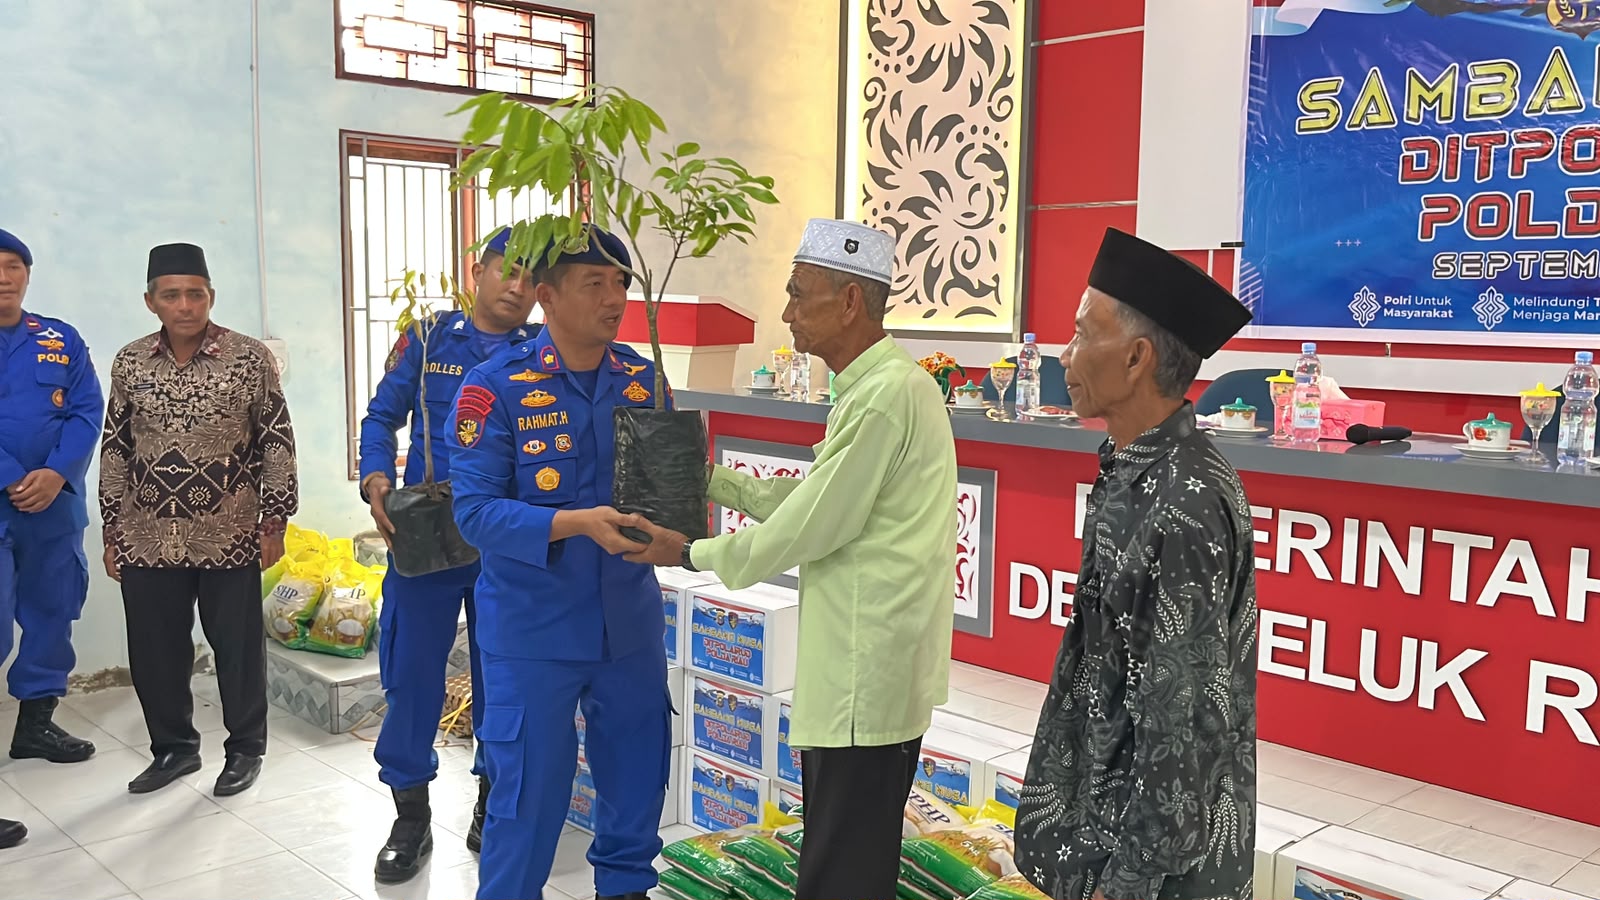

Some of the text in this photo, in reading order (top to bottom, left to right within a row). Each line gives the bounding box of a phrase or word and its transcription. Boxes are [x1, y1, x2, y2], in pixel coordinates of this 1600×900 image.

[1296, 46, 1600, 135] SAMBA
[1399, 125, 1600, 184] DITPO
[1418, 188, 1600, 242] POLD
[1383, 308, 1454, 320] Masyarakat
[1384, 295, 1452, 306] Polri Untuk
[1512, 309, 1570, 323] Menjaga
[1513, 296, 1590, 309] Melindungi
[1258, 609, 1488, 723] ELUK
